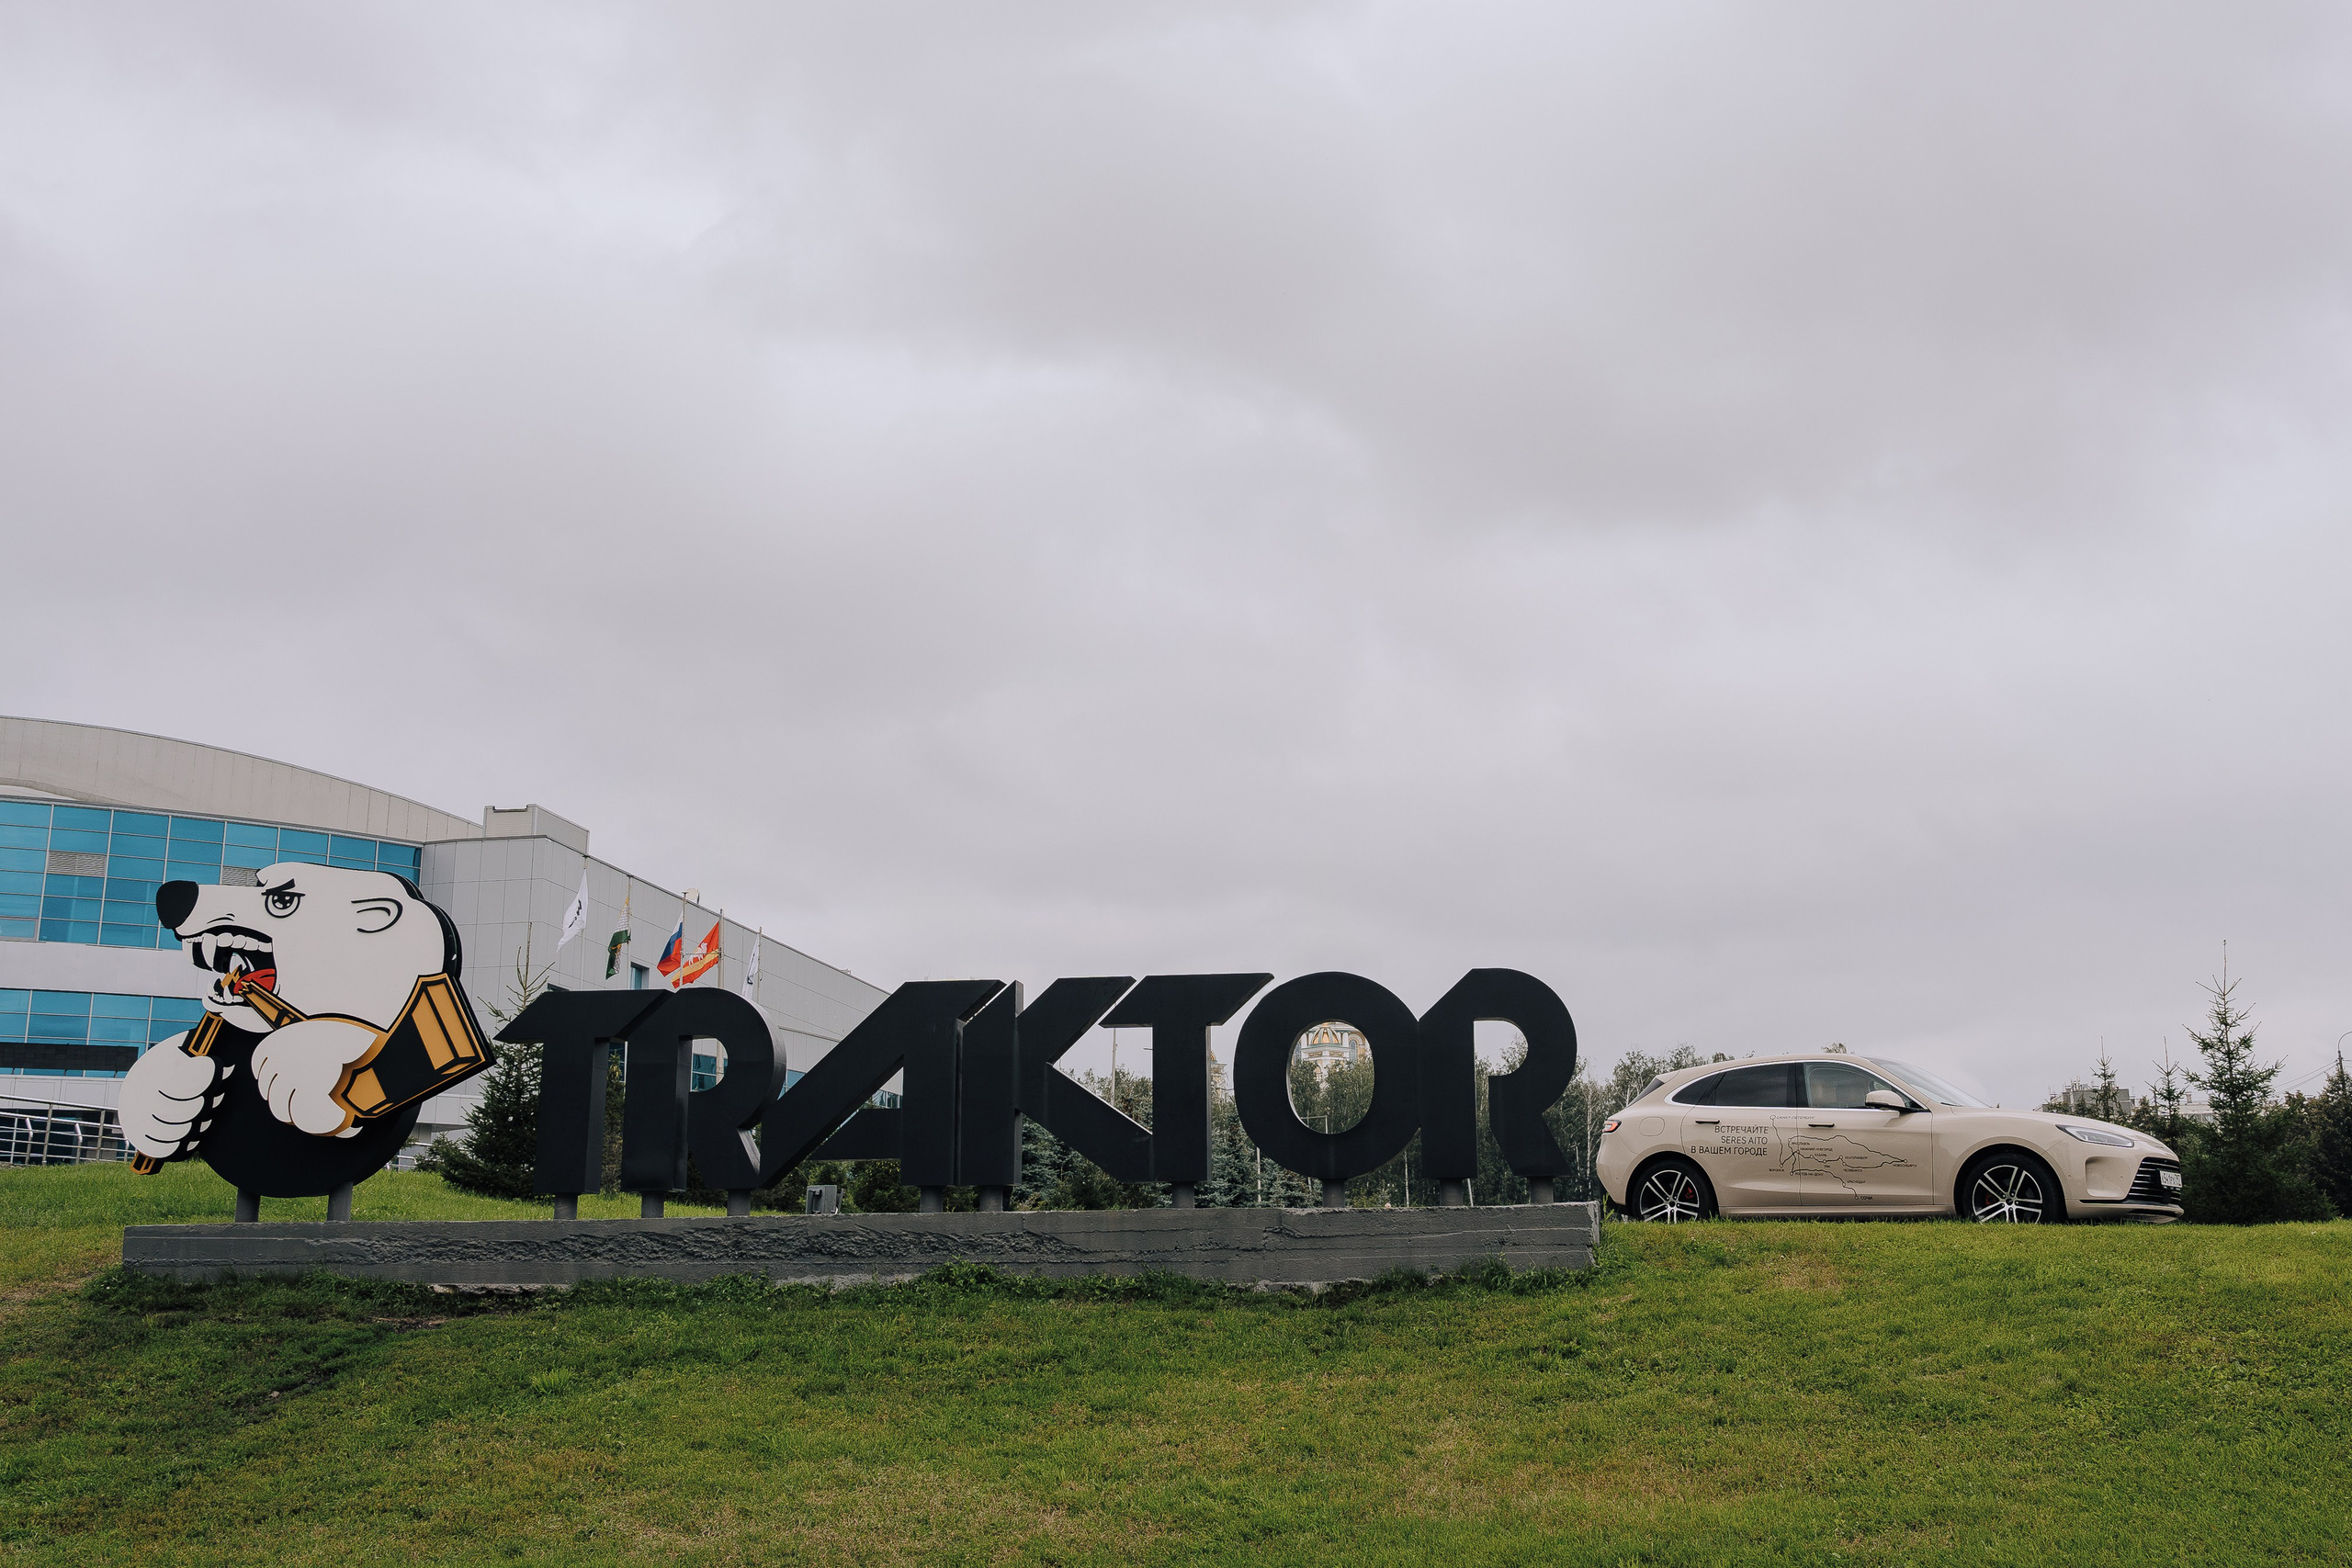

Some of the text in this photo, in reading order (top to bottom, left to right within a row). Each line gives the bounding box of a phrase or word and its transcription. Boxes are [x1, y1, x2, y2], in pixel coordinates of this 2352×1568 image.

[496, 968, 1577, 1194] TRAKTOR
[1714, 1124, 1769, 1134] ВСТРЕЧАЙТЕ
[1721, 1135, 1768, 1145] SERES AITO
[1690, 1145, 1768, 1156] В ВАШЕМ ГОРОДЕ
